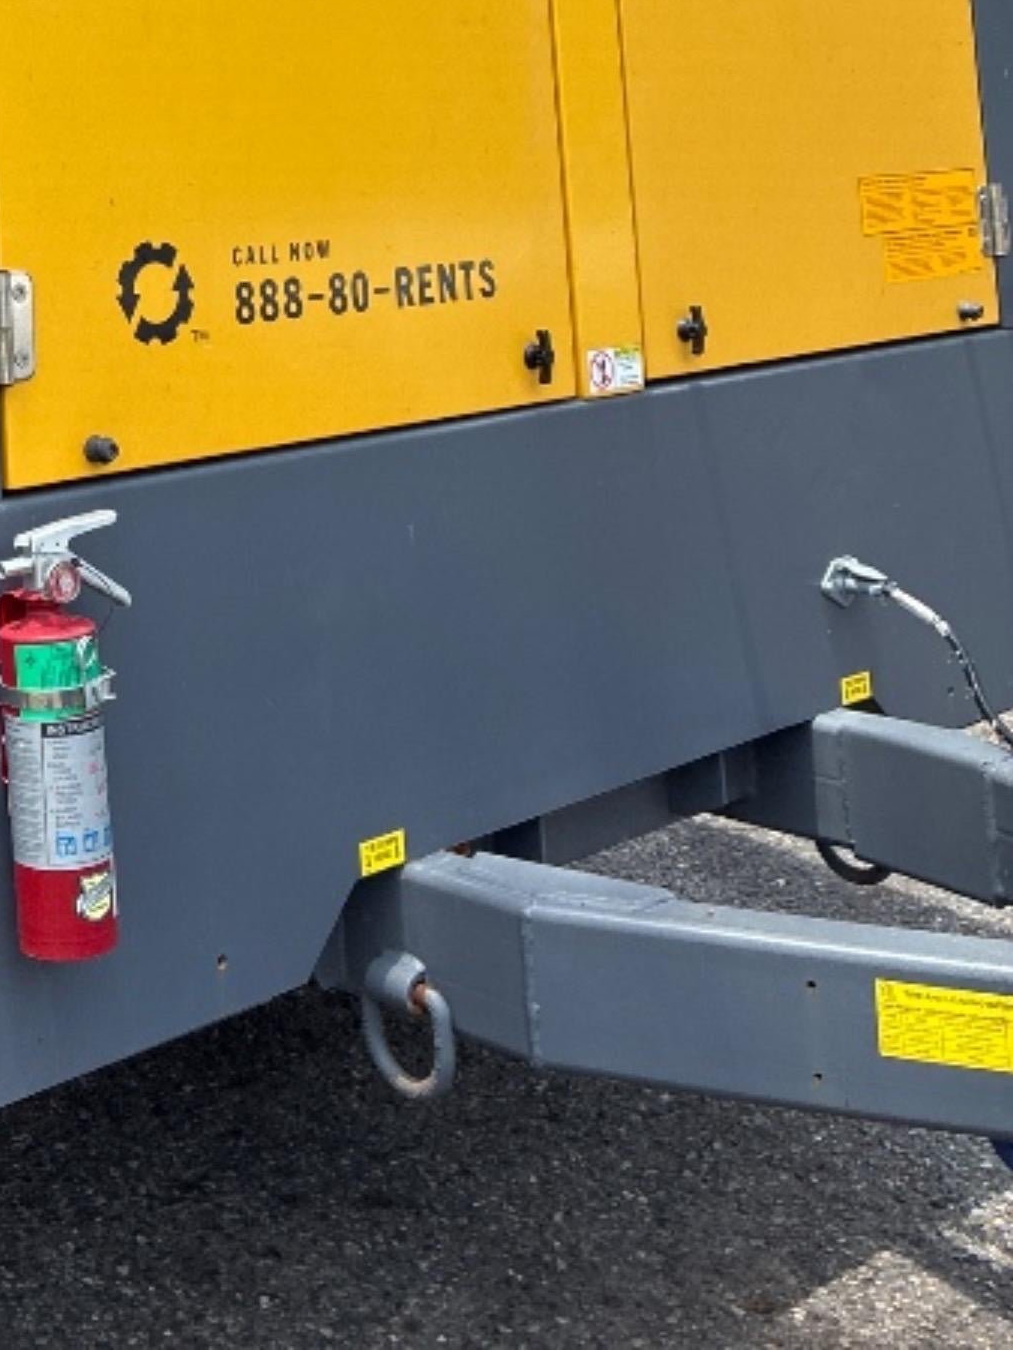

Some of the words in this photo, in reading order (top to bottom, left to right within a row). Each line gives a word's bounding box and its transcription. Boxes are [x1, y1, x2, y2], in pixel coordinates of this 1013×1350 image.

[232, 245, 280, 267] CALL
[289, 239, 331, 262] NOW
[236, 257, 497, 325] 888-80-RENTS
